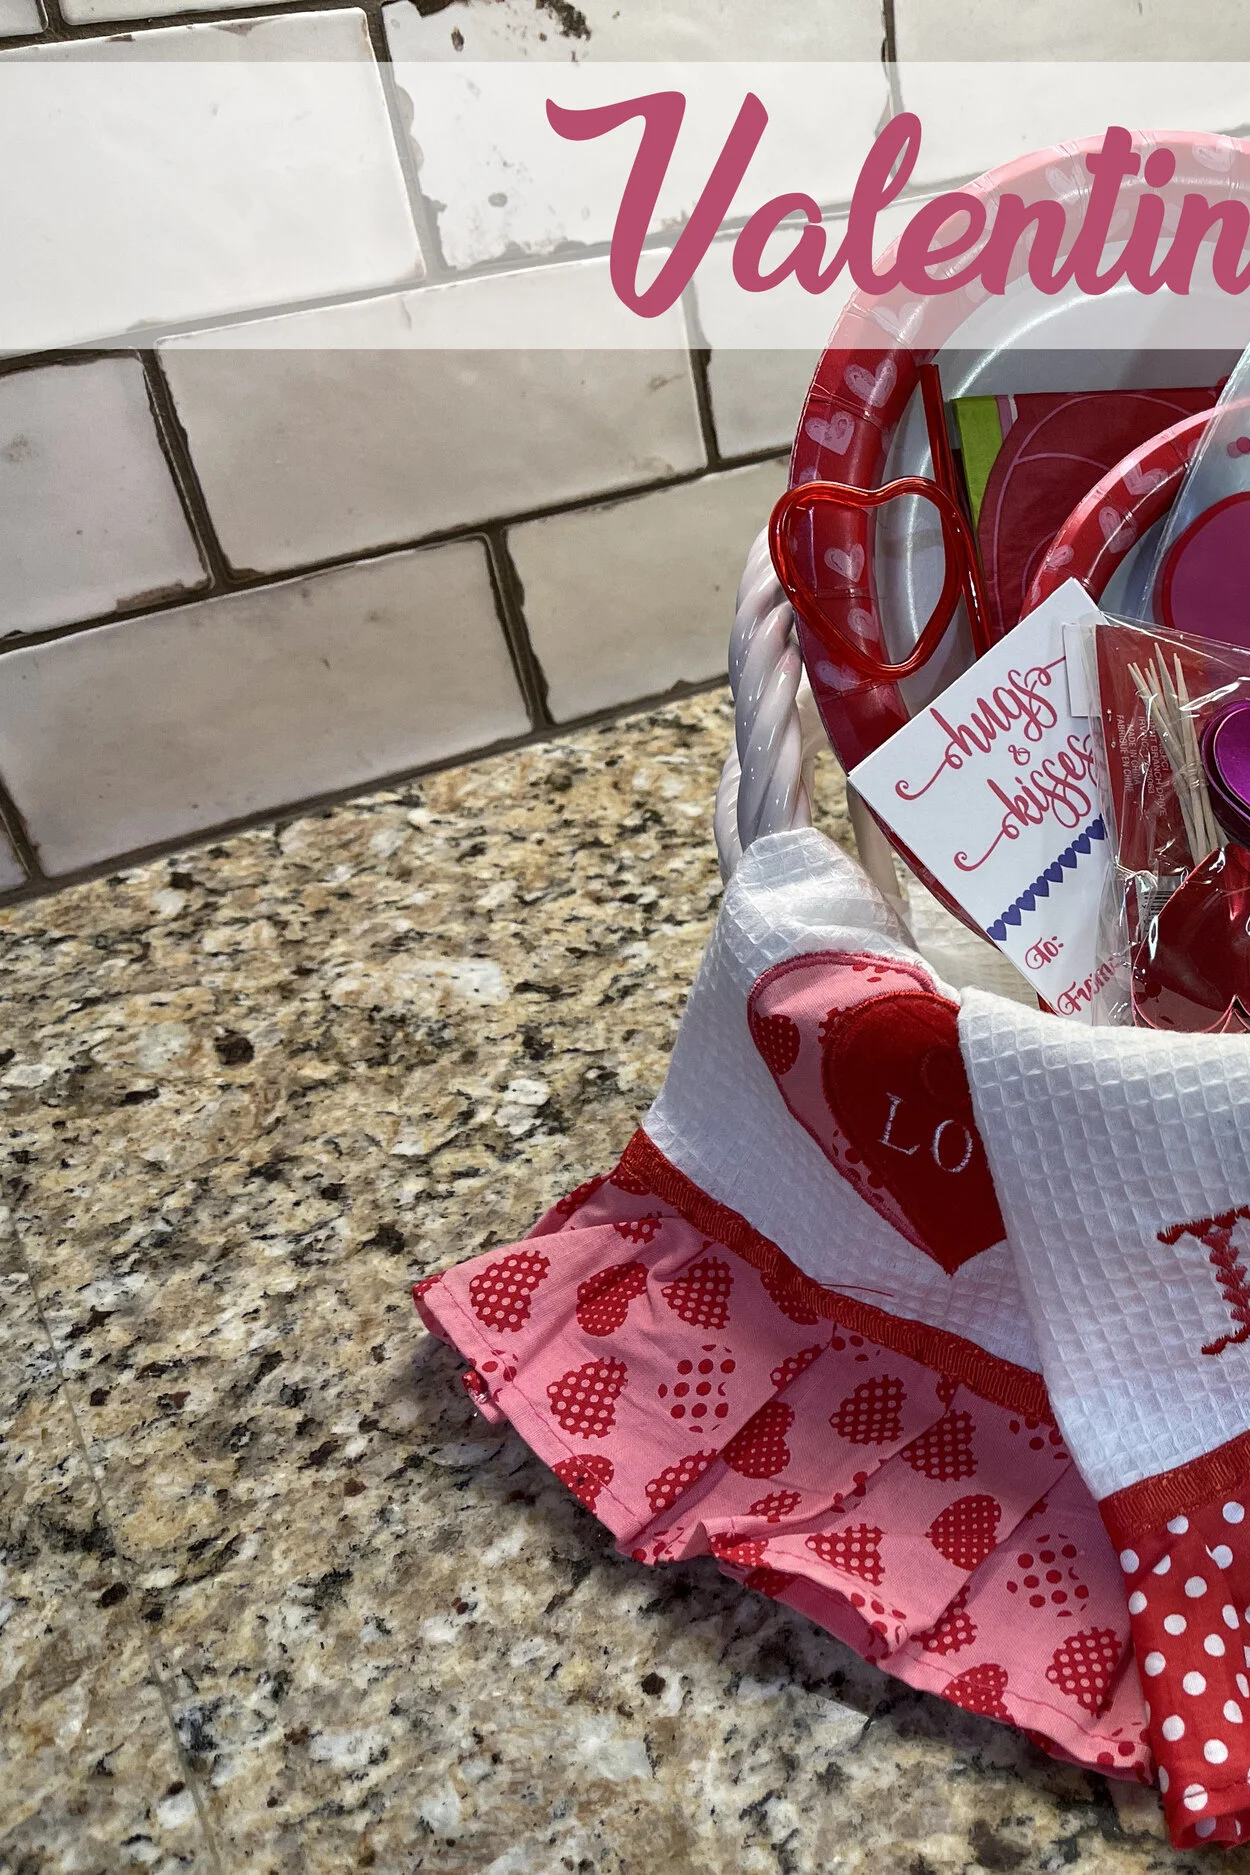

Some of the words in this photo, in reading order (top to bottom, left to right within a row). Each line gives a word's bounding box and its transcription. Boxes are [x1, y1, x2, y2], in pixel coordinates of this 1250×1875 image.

[895, 655, 1067, 800] hugs
[1127, 723, 1136, 747] MADE
[1007, 744, 1031, 766] &
[1121, 755, 1130, 768] EN
[1128, 748, 1138, 758] IN
[1149, 744, 1164, 785] BRANCH
[1123, 768, 1134, 793] CHINE
[1130, 759, 1141, 785] CHINA
[1155, 786, 1167, 816] DRIVE
[1025, 935, 1064, 970] To:
[876, 1092, 973, 1174] LO
